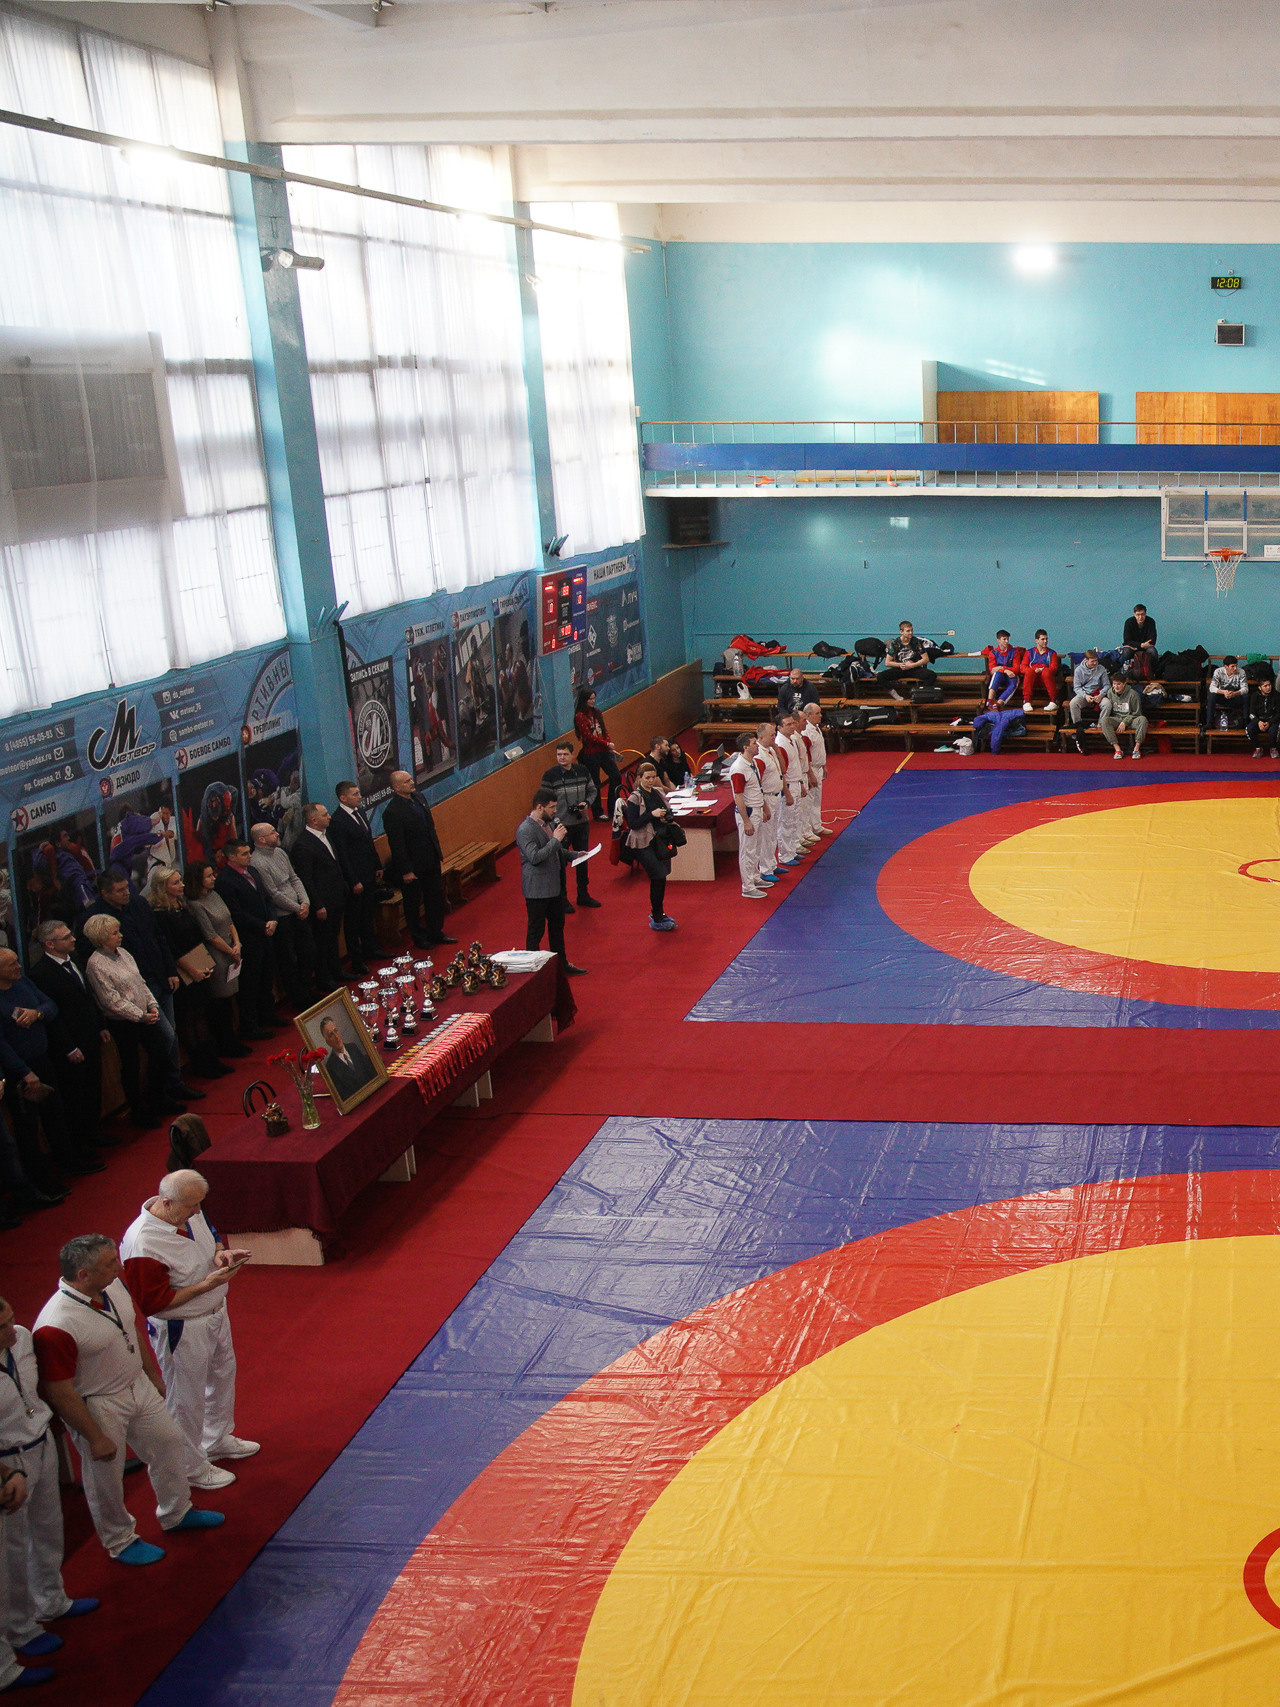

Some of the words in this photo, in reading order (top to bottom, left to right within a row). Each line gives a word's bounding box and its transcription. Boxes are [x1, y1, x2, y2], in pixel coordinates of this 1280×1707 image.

[1216, 277, 1240, 288] 12:08
[350, 668, 368, 683] ЗАПИСЬ
[371, 660, 389, 675] СЕКЦИИ
[109, 742, 157, 768] МЕТЕОР
[189, 743, 212, 760] БОЕВОЕ
[212, 736, 231, 752] САМБО
[116, 770, 141, 788] ДЗЮДО
[29, 801, 57, 820] САМБО
